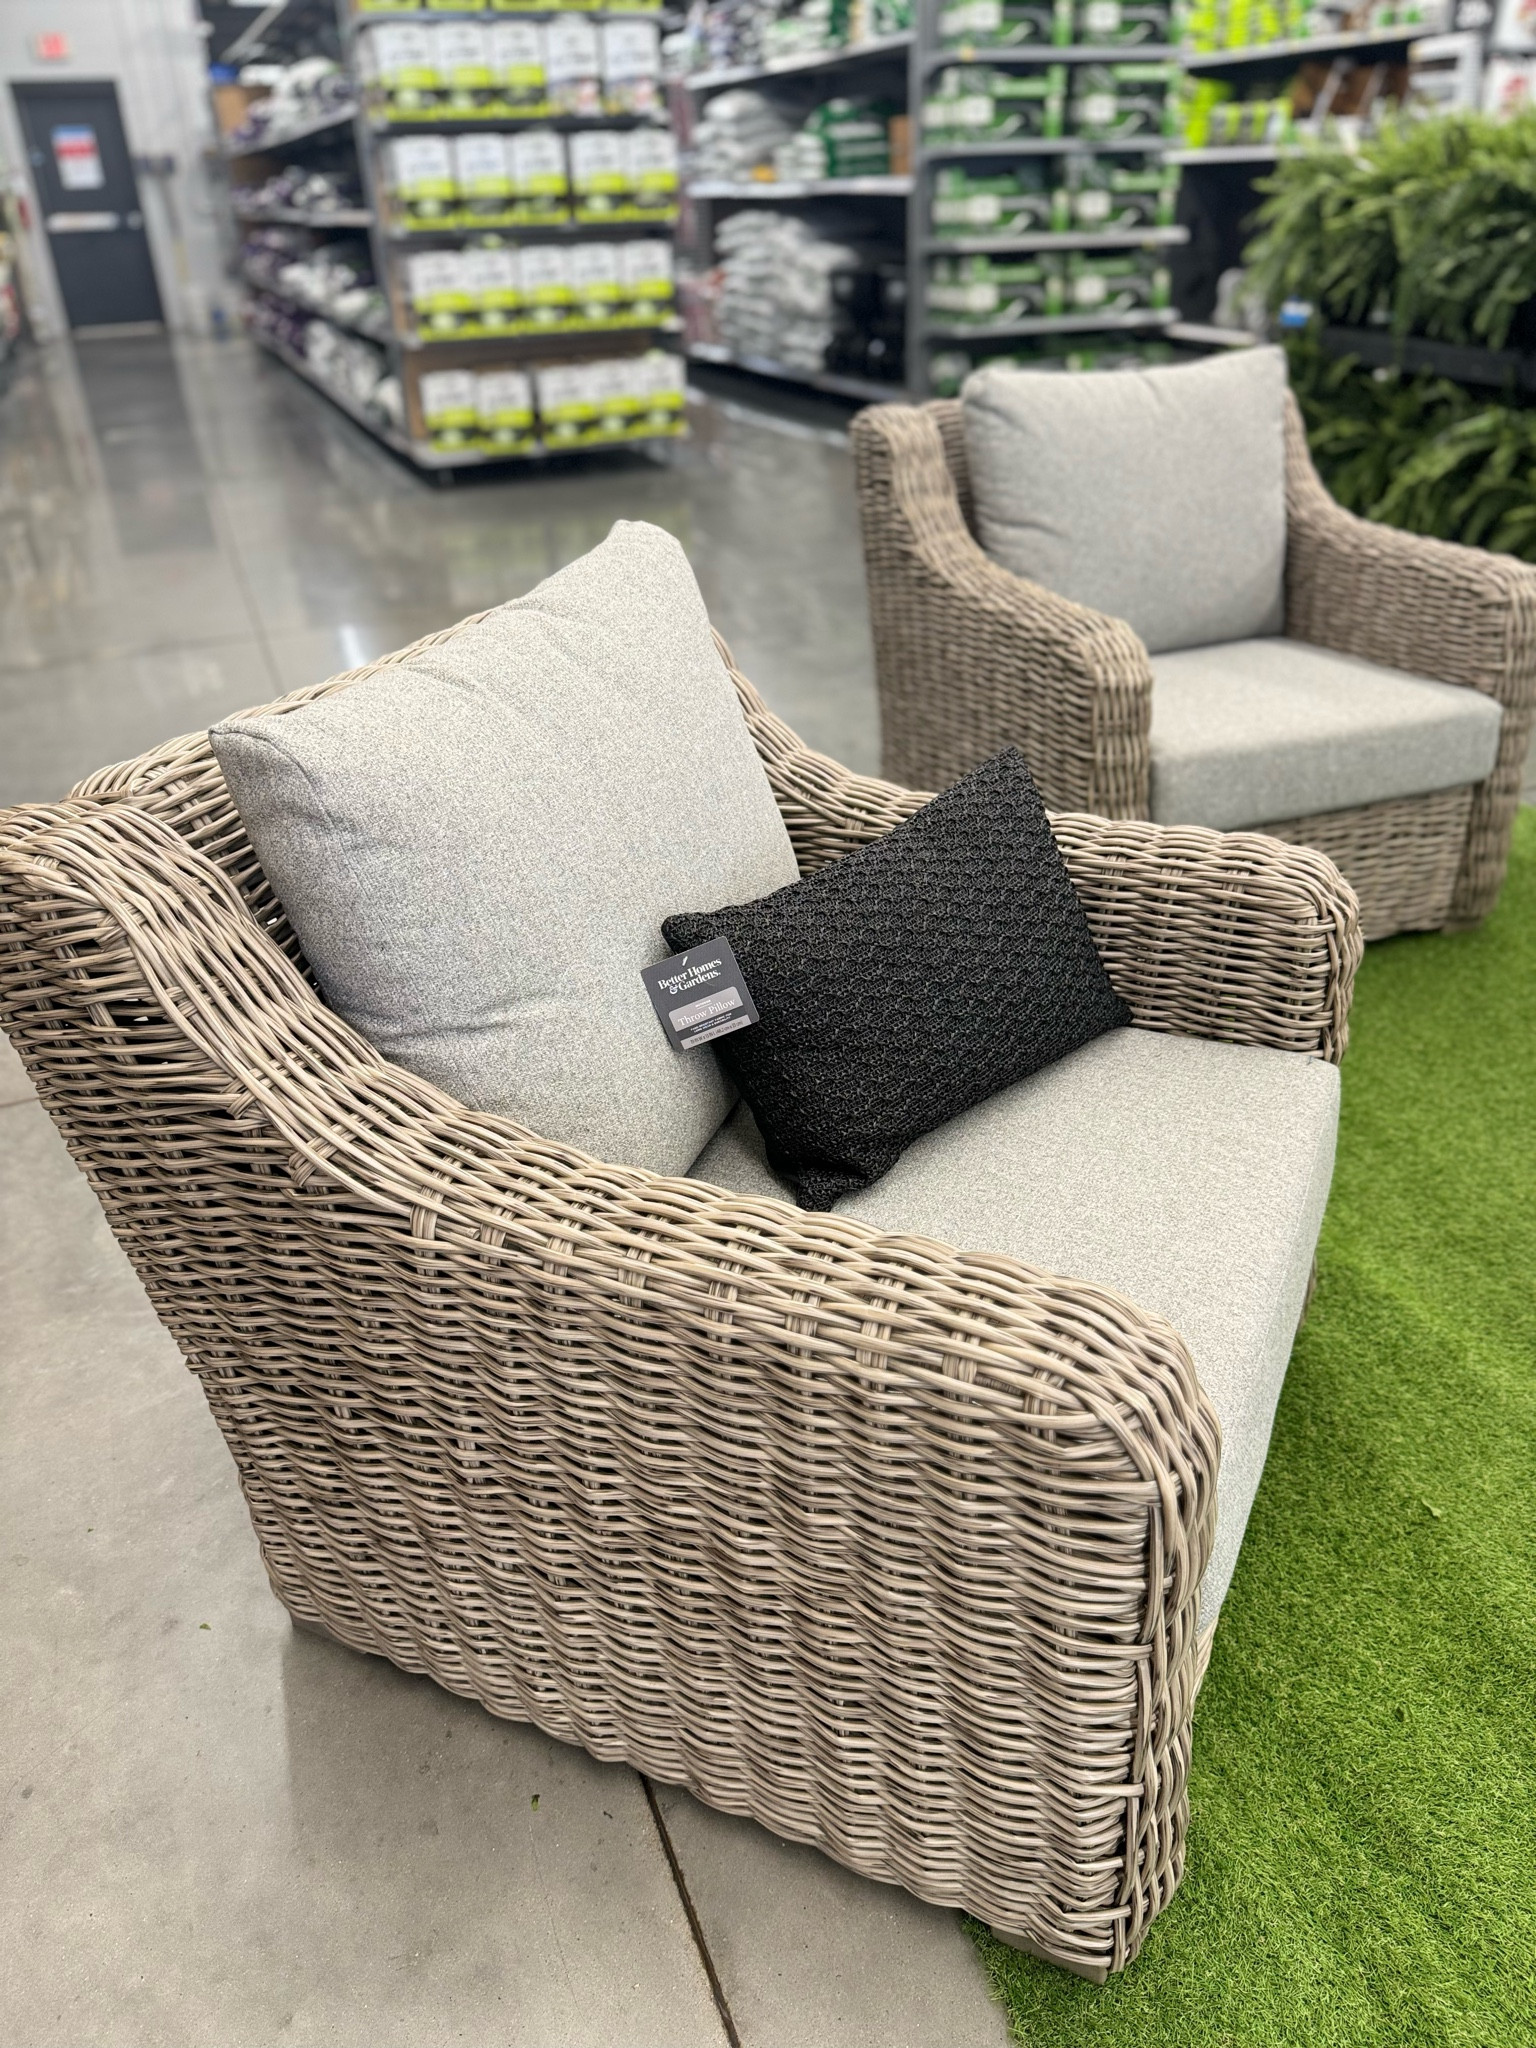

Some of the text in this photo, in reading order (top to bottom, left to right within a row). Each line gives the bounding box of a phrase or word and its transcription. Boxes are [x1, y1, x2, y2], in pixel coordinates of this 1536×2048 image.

[657, 958, 722, 990] Better Homes
[678, 1010, 707, 1026] Throw
[708, 998, 736, 1014] Pillow
